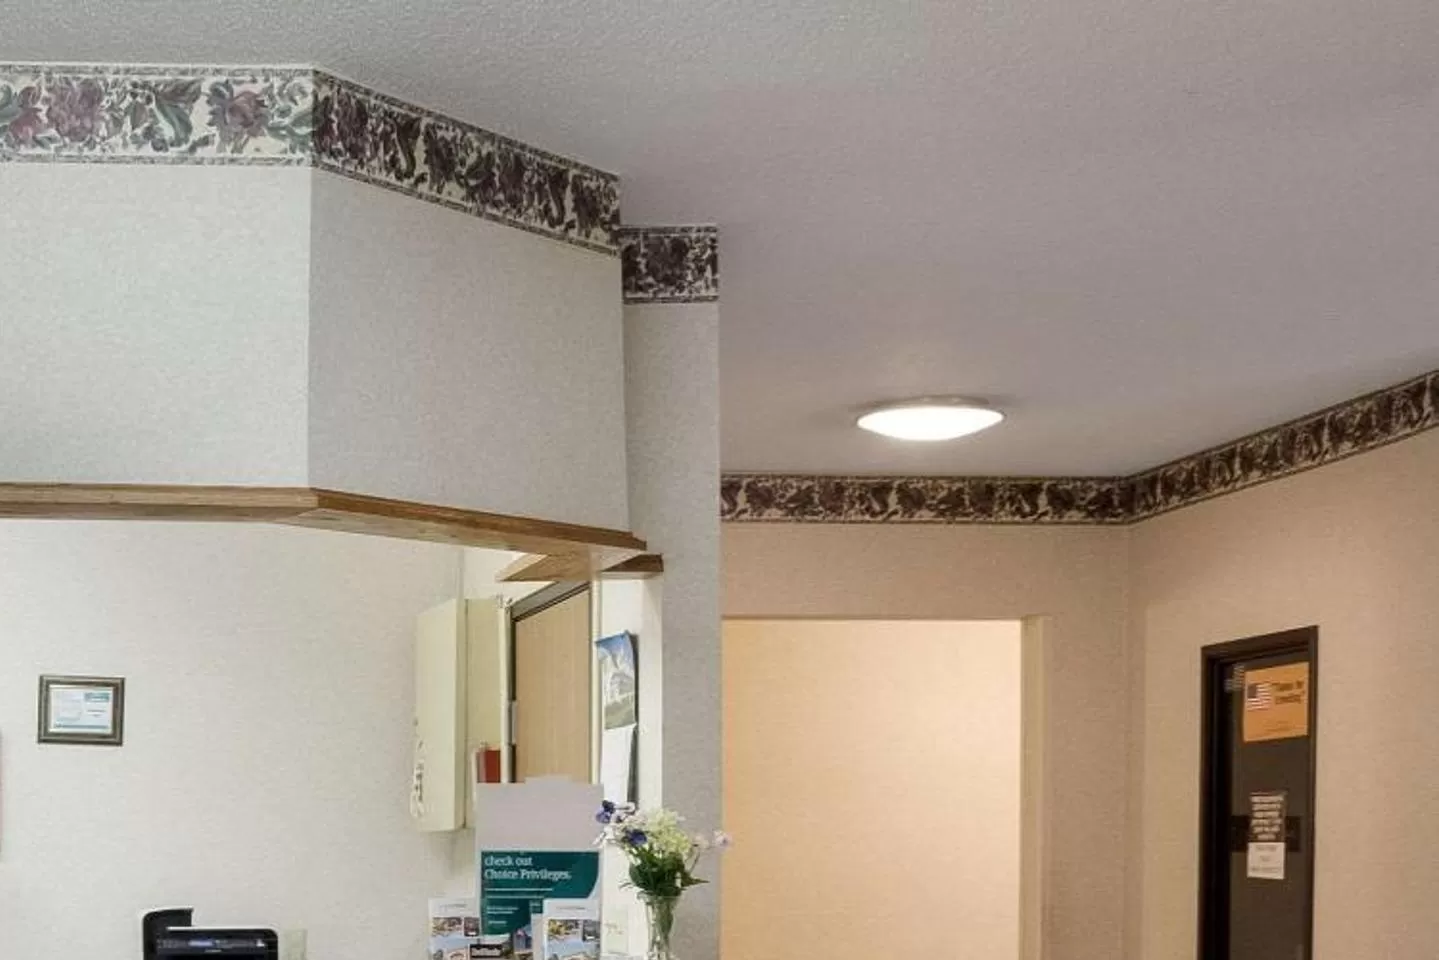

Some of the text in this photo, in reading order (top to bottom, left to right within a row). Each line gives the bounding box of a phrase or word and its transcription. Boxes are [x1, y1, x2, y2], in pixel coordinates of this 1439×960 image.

[484, 856, 533, 866] check out
[484, 869, 519, 879] Choice
